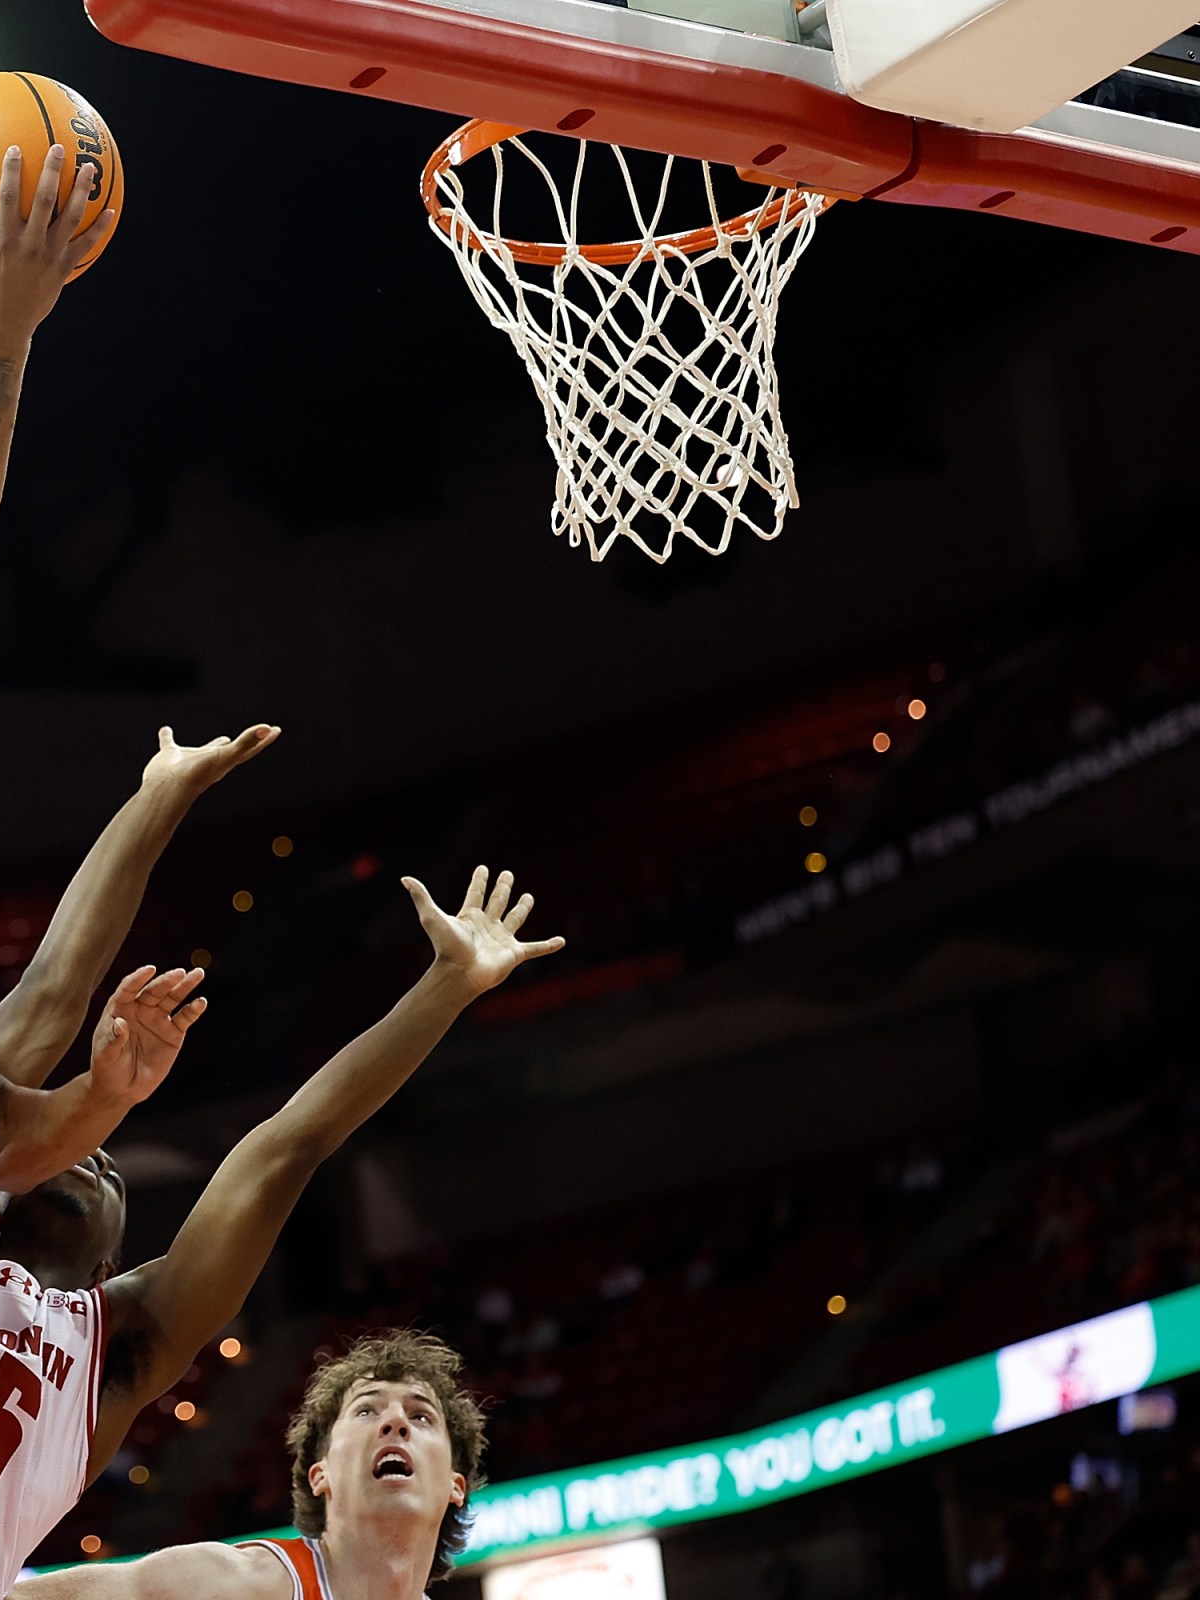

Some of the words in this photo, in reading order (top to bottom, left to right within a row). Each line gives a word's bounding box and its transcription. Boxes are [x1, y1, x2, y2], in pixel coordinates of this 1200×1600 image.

[564, 1452, 722, 1531] PRIDE?
[724, 1428, 813, 1497] YOU
[812, 1400, 895, 1472] GOT
[896, 1387, 946, 1447] IT.
